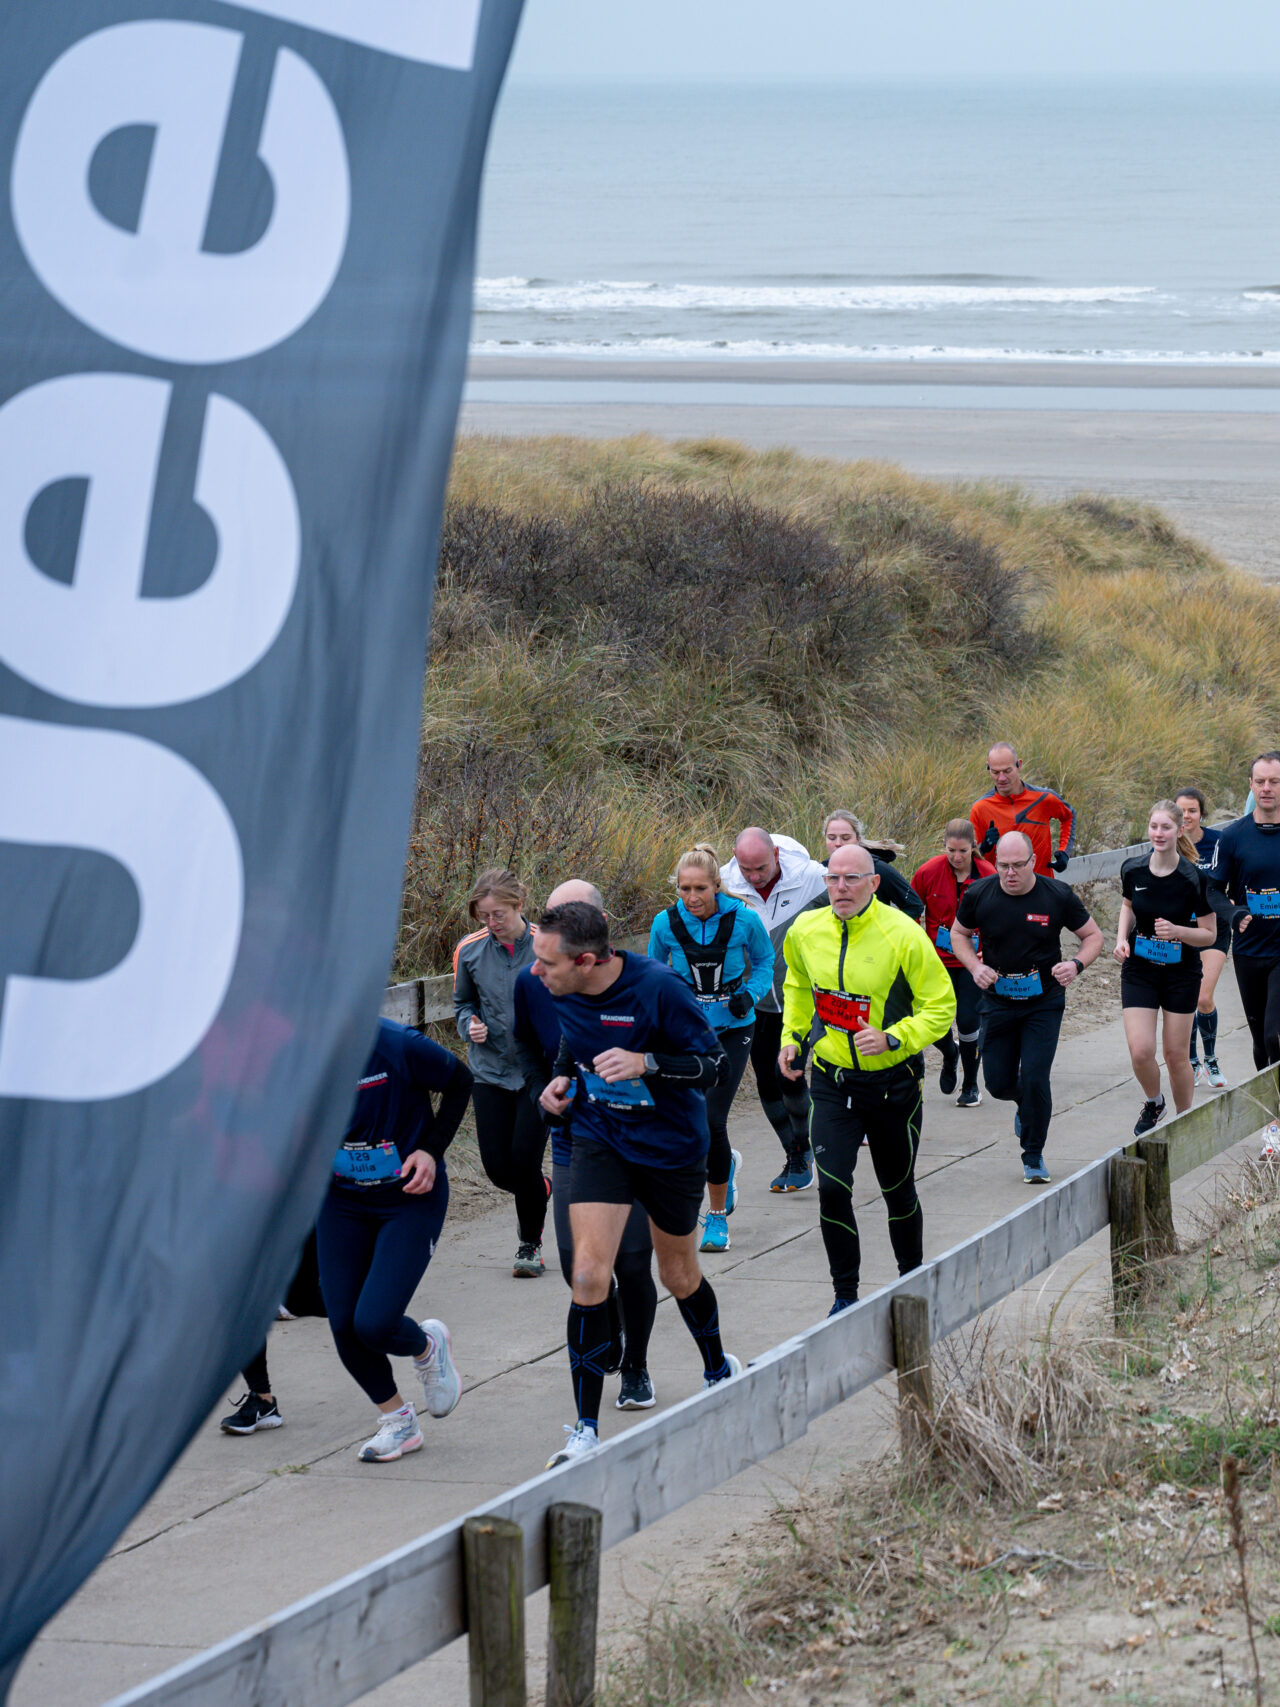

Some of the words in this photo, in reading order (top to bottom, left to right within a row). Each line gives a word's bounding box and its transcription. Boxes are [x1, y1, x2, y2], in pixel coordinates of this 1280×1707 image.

[831, 998, 848, 1009] 209
[600, 1014, 635, 1022] BRANDWEER
[357, 1071, 388, 1085] ANDWEER
[348, 1152, 370, 1161] 129
[349, 1163, 377, 1172] Julia
